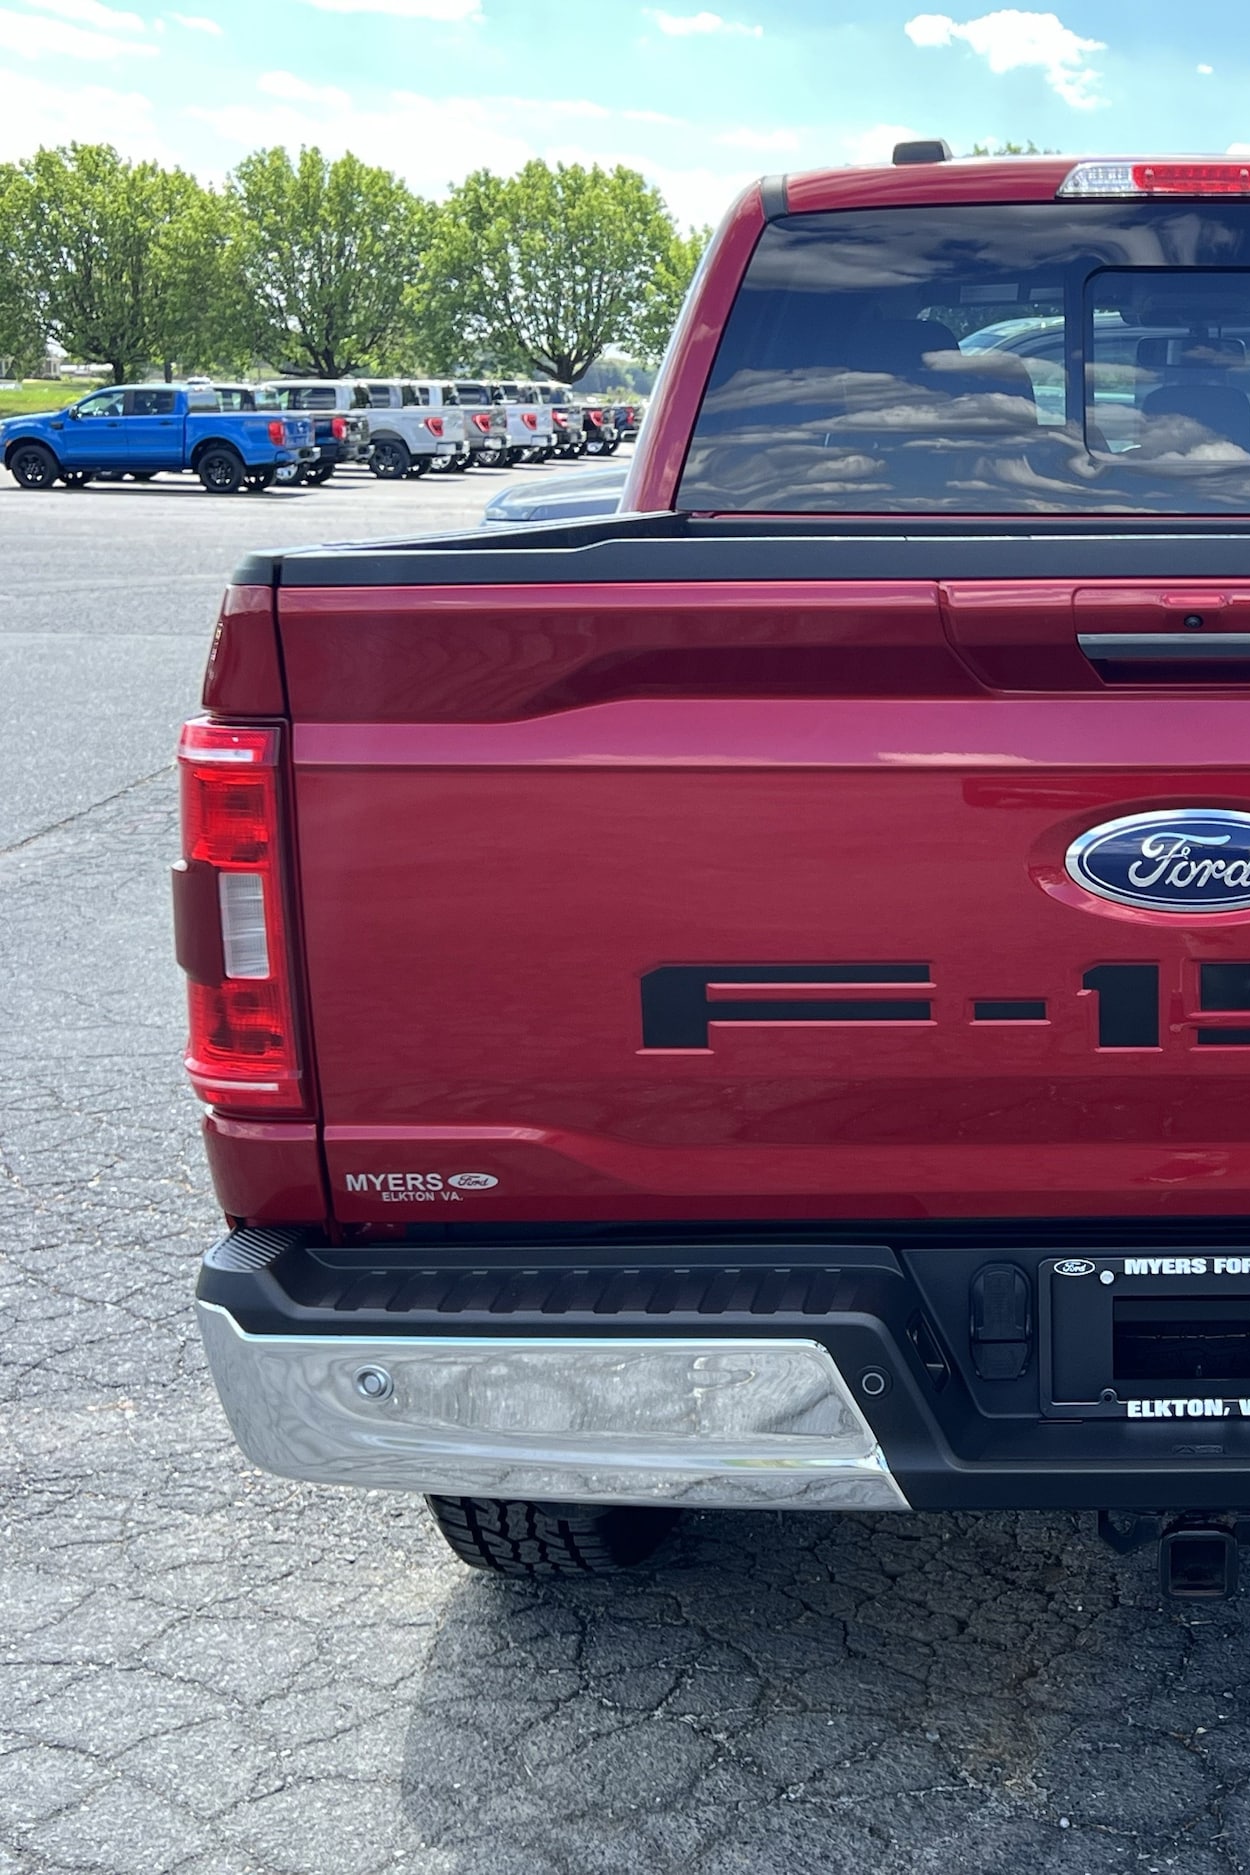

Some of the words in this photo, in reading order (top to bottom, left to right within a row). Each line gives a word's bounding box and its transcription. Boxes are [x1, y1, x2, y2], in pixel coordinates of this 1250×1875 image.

[346, 1173, 443, 1192] MYERS
[458, 1174, 489, 1187] Ford
[382, 1191, 434, 1202] ELKTON
[441, 1191, 463, 1201] VA.
[1061, 1261, 1088, 1272] Ford
[1124, 1258, 1207, 1275] MYERS
[1127, 1400, 1230, 1418] ELKTON,
